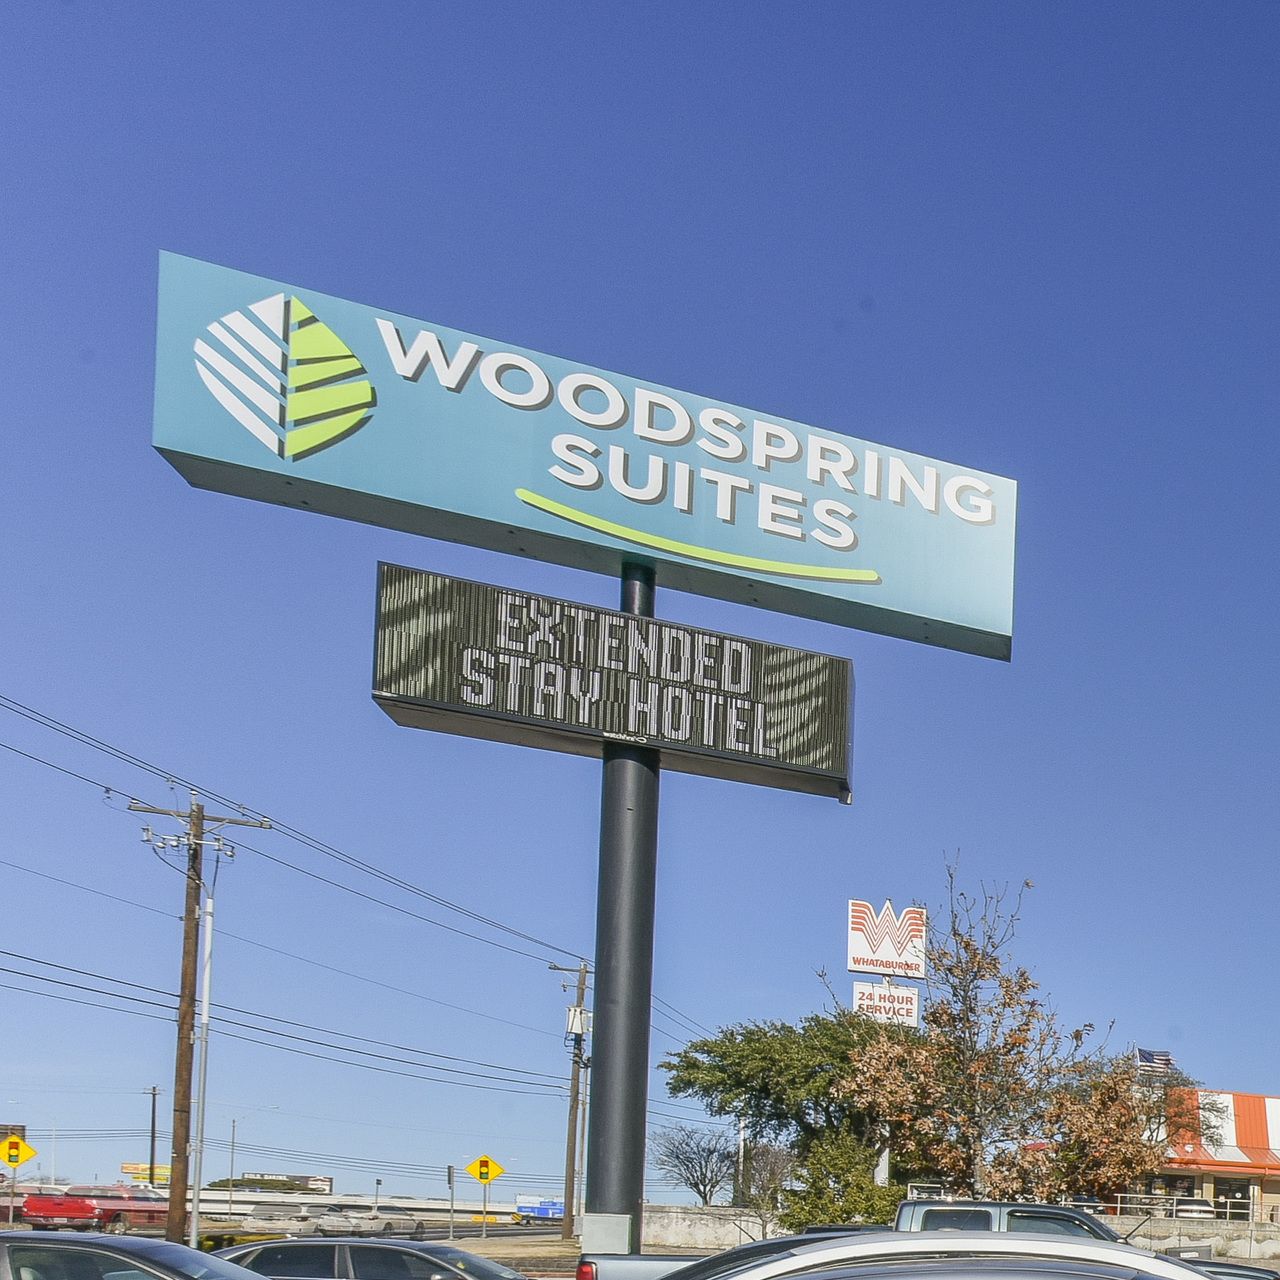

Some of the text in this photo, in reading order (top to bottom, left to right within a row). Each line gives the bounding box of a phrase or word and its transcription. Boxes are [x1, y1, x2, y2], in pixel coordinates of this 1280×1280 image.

[375, 317, 995, 524] WOODSPRING
[548, 433, 857, 549] SUITES
[498, 591, 753, 694] EXTENDED
[461, 647, 778, 758] STAY HOTEL
[857, 1003, 913, 1018] SERVICE
[858, 991, 914, 1006] 24 HOUR
